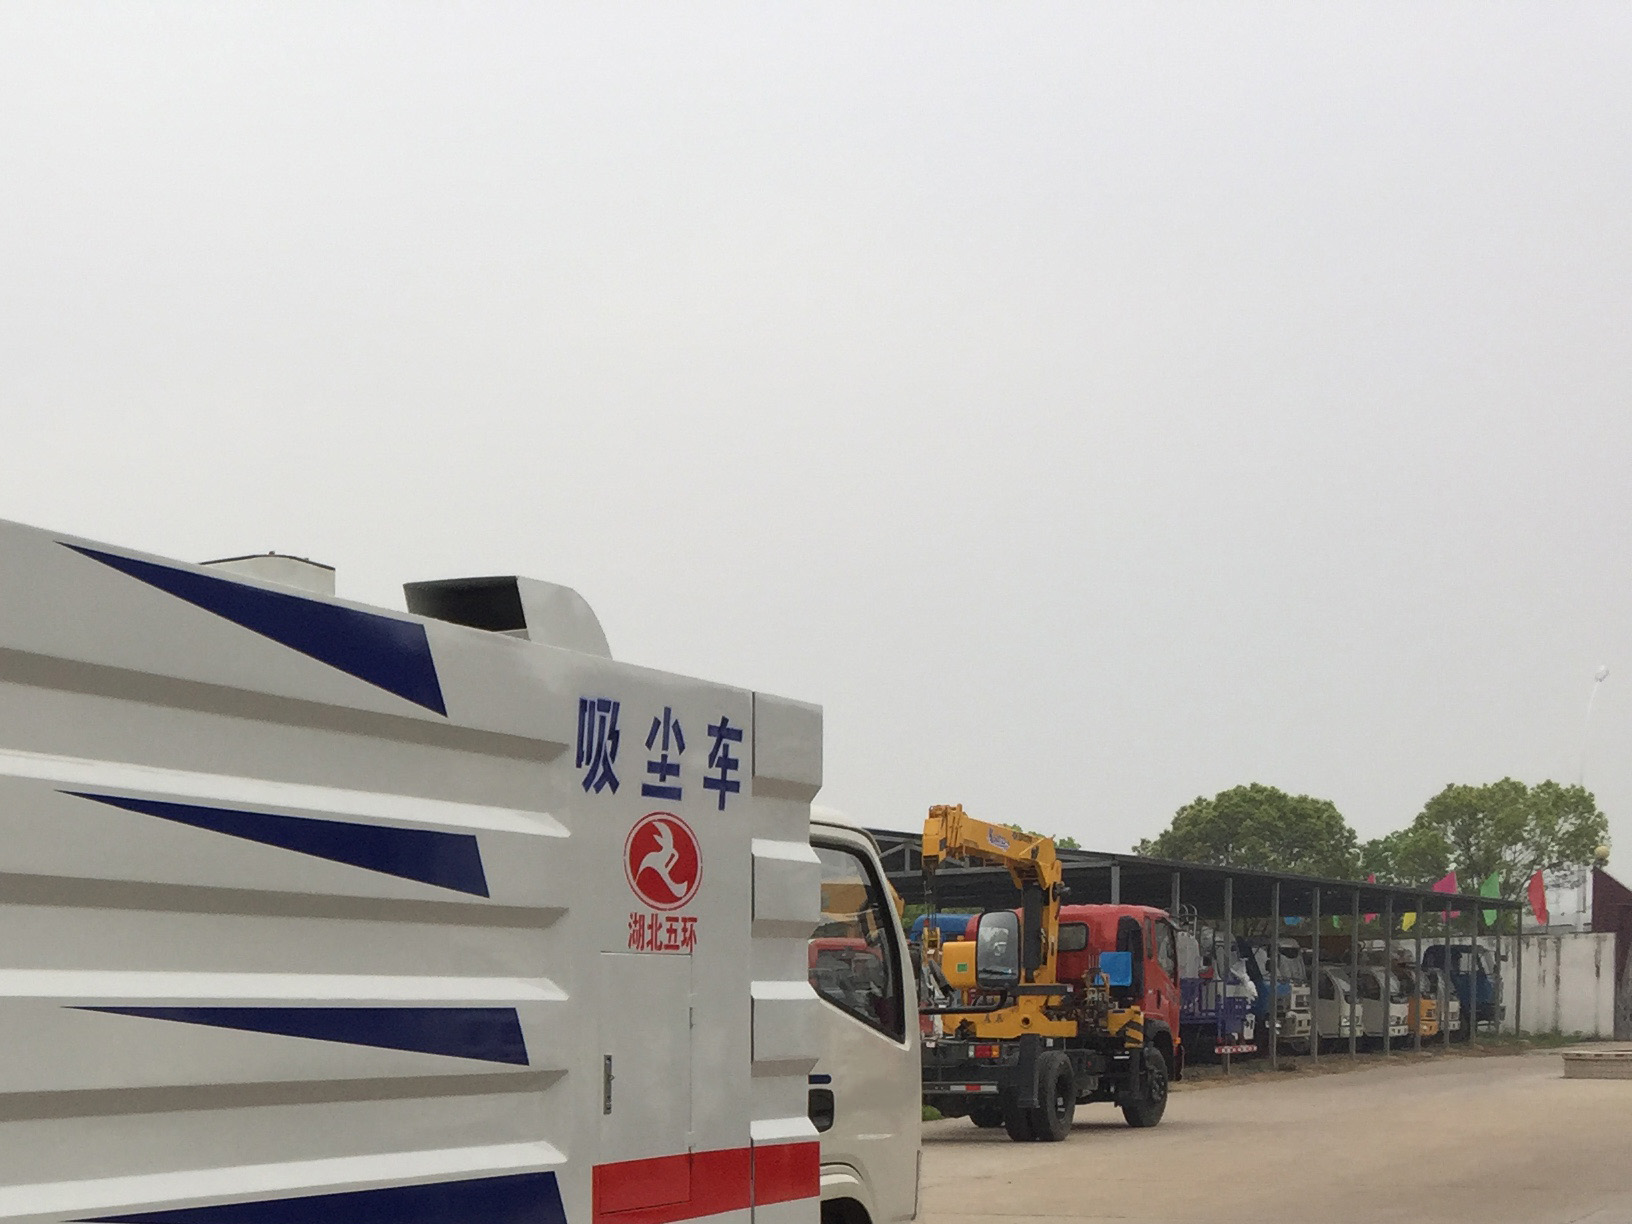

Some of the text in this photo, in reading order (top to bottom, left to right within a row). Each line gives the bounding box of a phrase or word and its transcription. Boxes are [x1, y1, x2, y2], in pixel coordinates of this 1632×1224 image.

[575, 697, 743, 811] 吸尘车
[627, 912, 699, 953] 湖北五环
